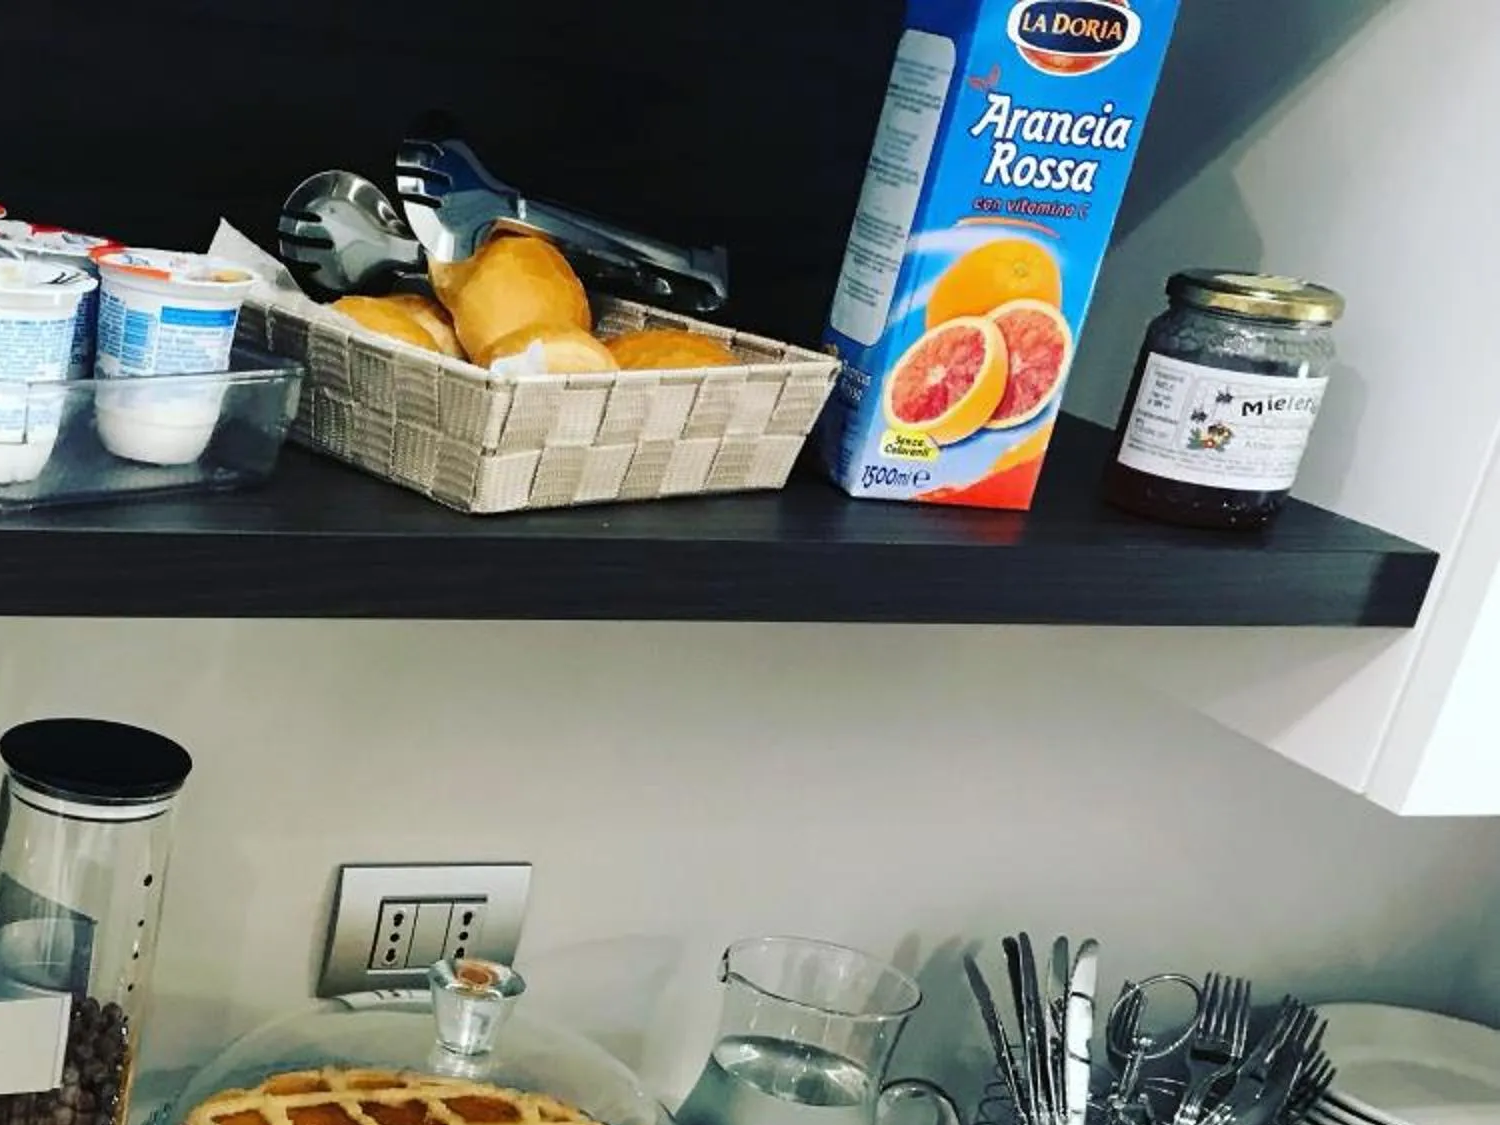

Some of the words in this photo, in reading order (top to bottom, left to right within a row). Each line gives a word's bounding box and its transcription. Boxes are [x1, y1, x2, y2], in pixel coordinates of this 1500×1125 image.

[1021, 12, 1047, 33] LA
[1052, 12, 1123, 43] DORIA
[970, 92, 1133, 150] Arancia
[983, 140, 1099, 193] Rossa
